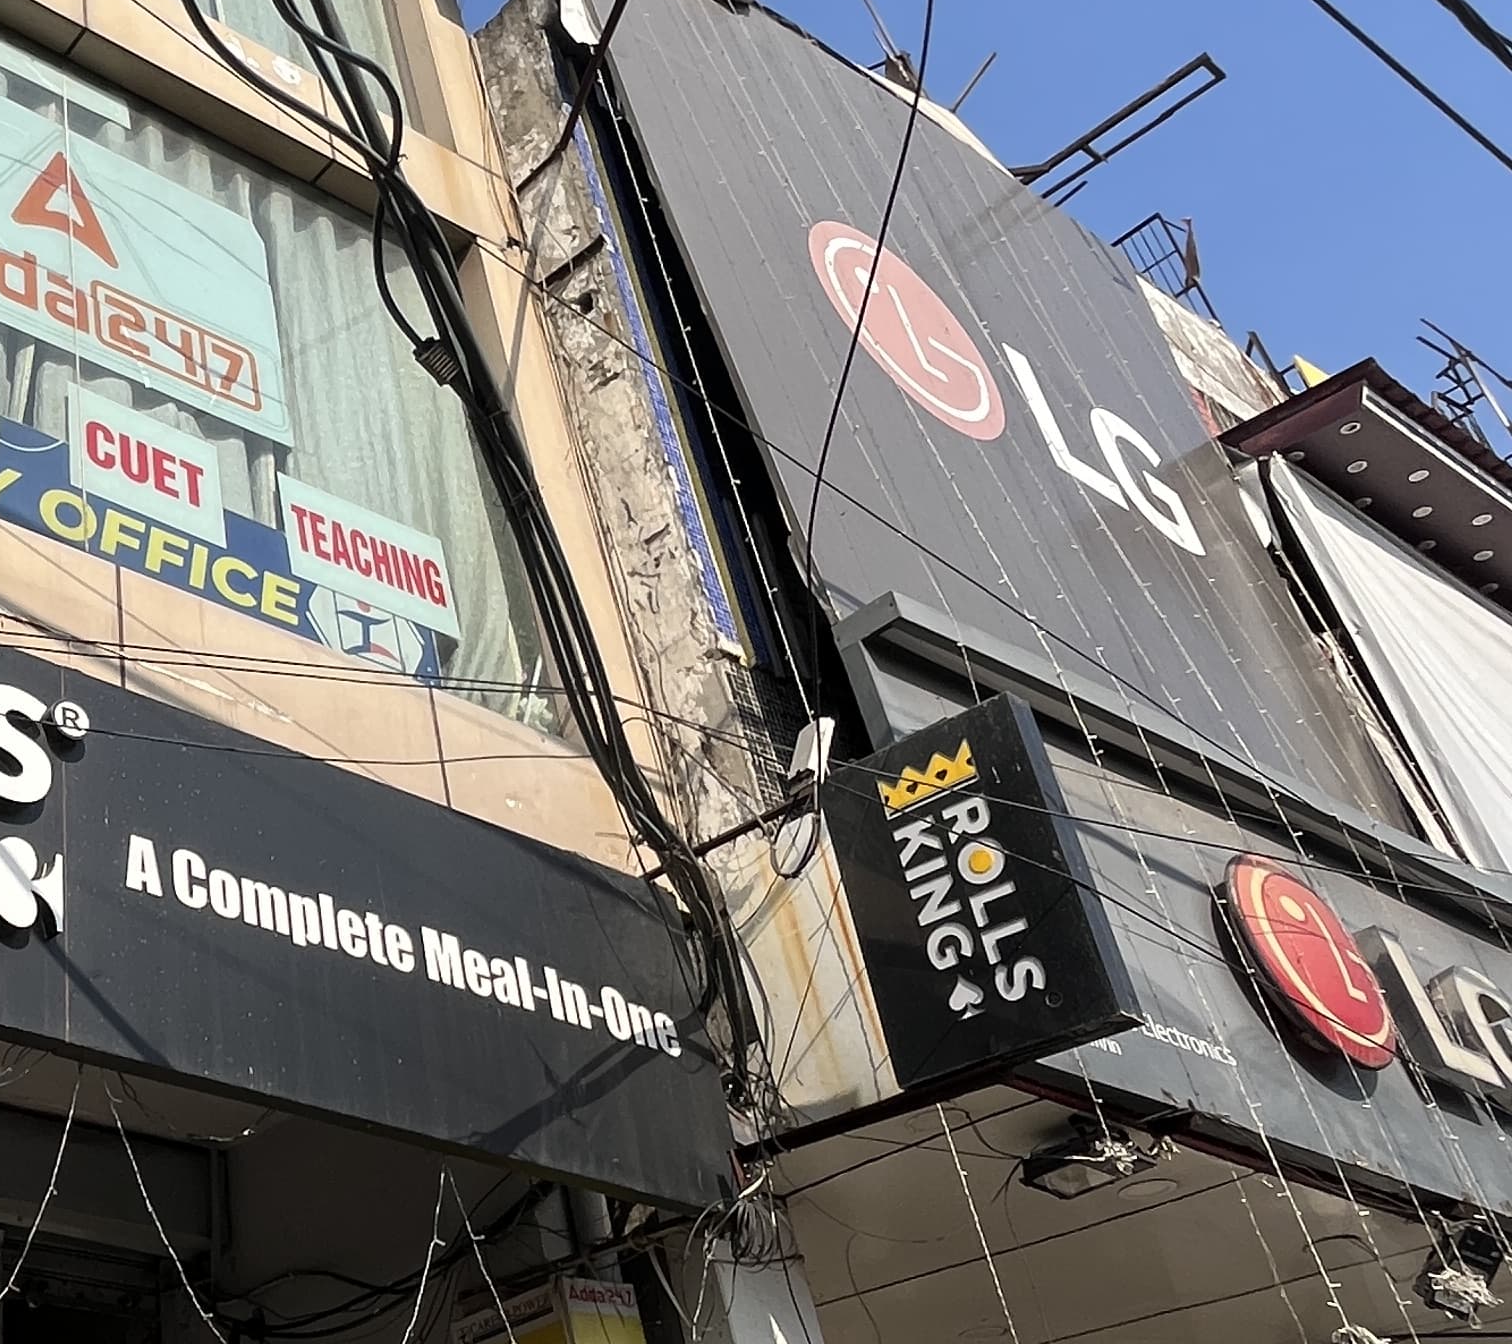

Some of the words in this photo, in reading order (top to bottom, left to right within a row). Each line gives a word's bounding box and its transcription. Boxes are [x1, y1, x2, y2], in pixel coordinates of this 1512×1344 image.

[86, 420, 203, 508] CUET
[1002, 343, 1206, 556] LG
[39, 488, 301, 626] OFFICE
[291, 504, 447, 608] TEACHING
[125, 834, 162, 897] A
[172, 848, 415, 973] Complete
[421, 926, 682, 1057] Meal-In-One
[894, 816, 974, 971] KING
[942, 797, 1046, 1004] ROLLS
